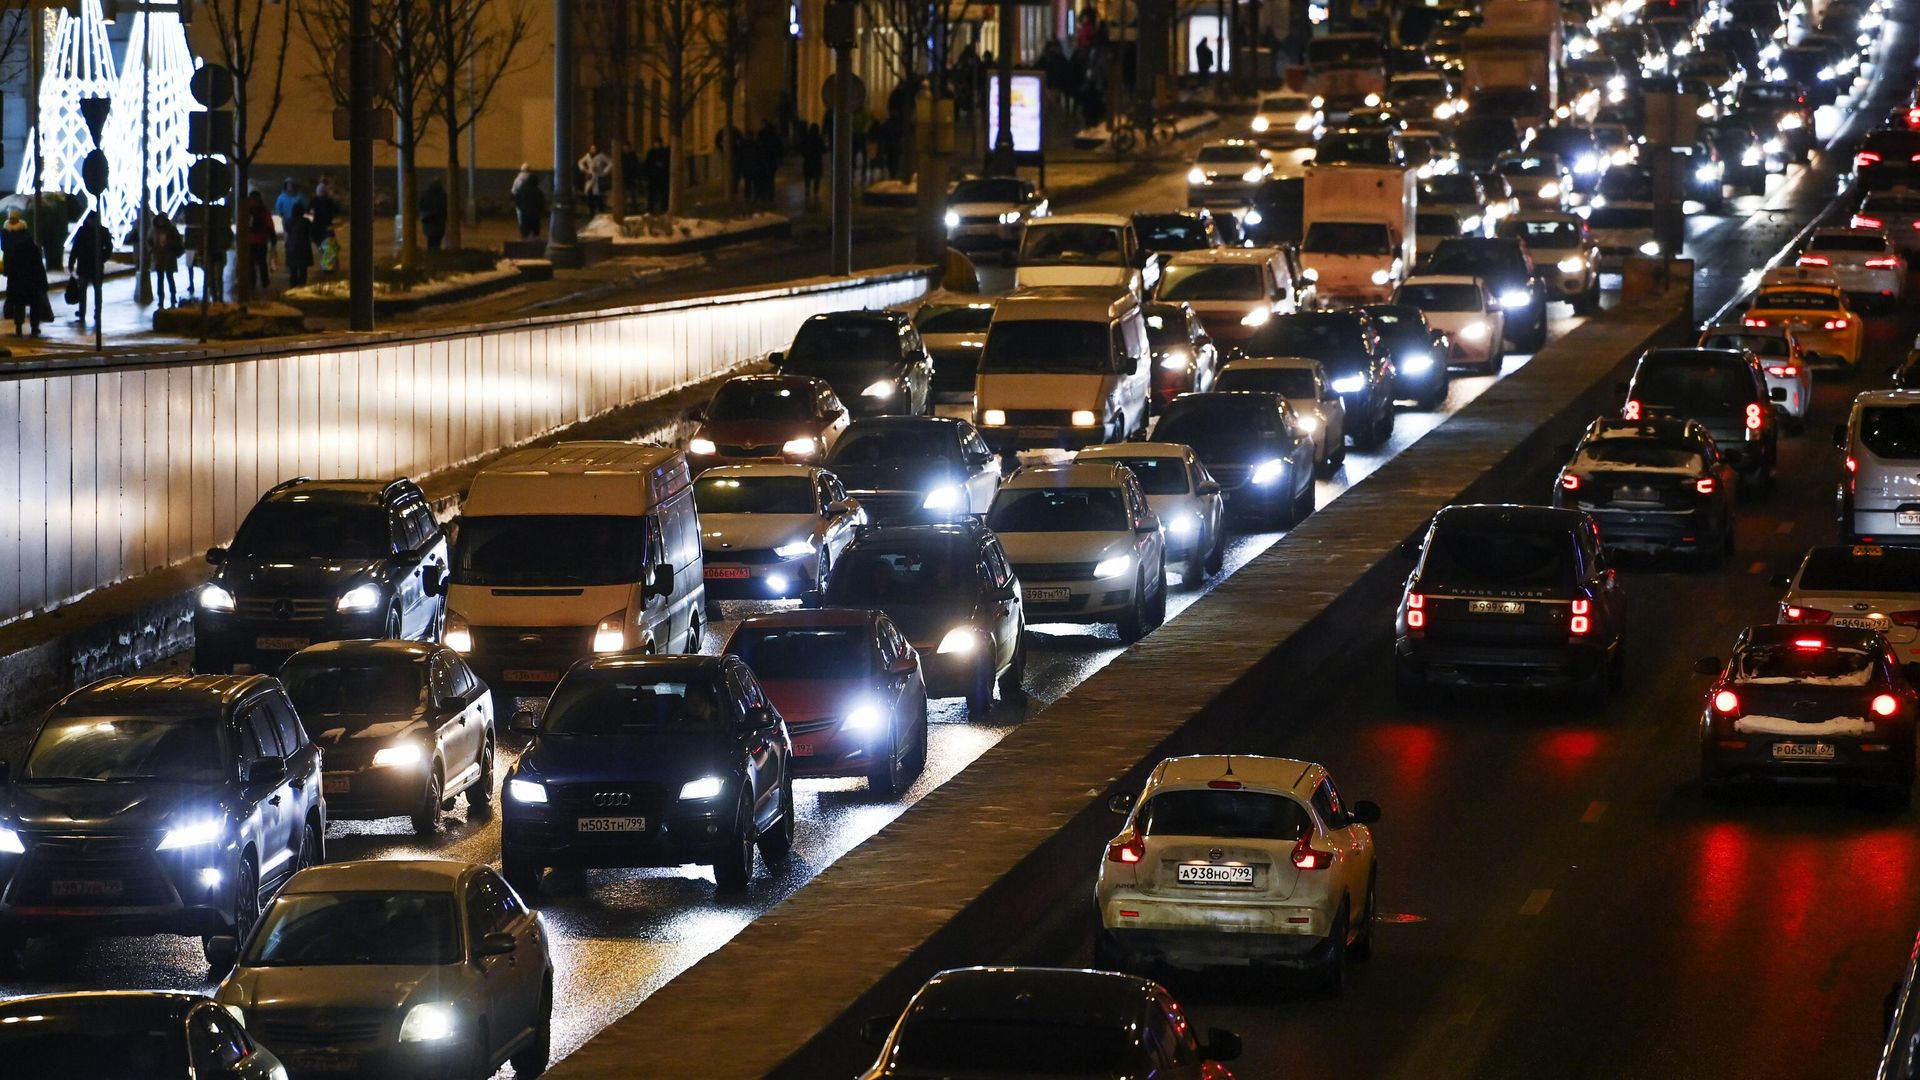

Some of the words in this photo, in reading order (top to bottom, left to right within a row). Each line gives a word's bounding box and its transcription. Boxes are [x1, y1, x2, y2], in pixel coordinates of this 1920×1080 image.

[581, 819, 624, 831] М503ТН
[626, 818, 642, 828] 799
[1182, 867, 1230, 879] А938НО
[1232, 868, 1250, 877] 799
